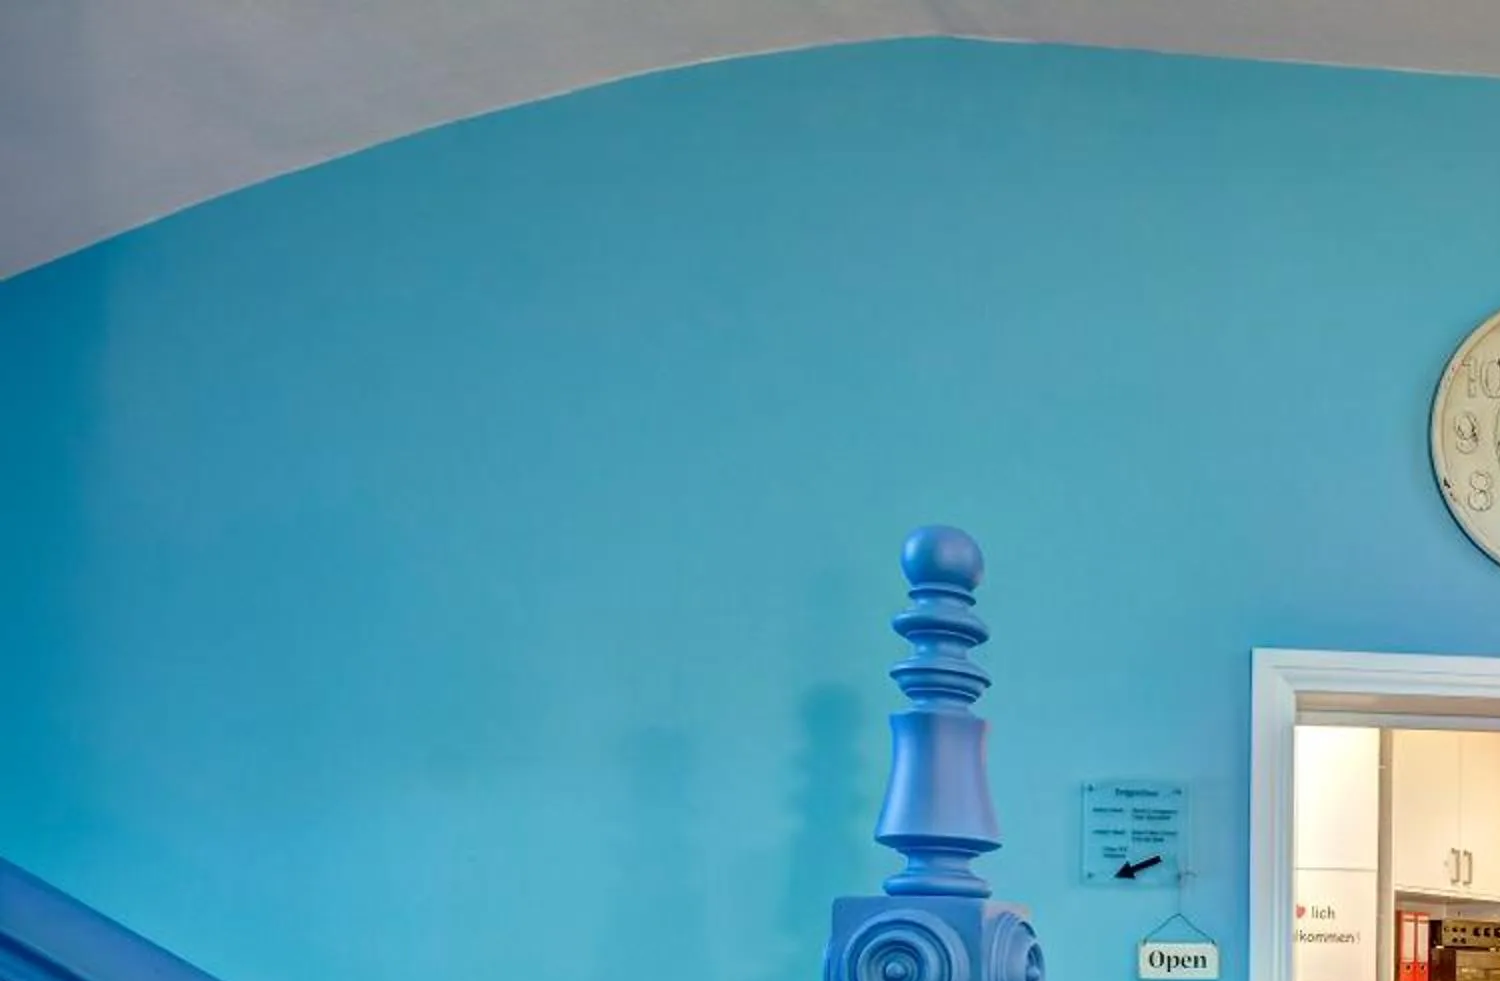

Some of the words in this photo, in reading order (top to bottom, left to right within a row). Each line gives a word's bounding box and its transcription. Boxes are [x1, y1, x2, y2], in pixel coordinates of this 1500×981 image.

[1454, 411, 1480, 454] 9
[1467, 471, 1493, 512] 8
[1149, 950, 1207, 972] Open
